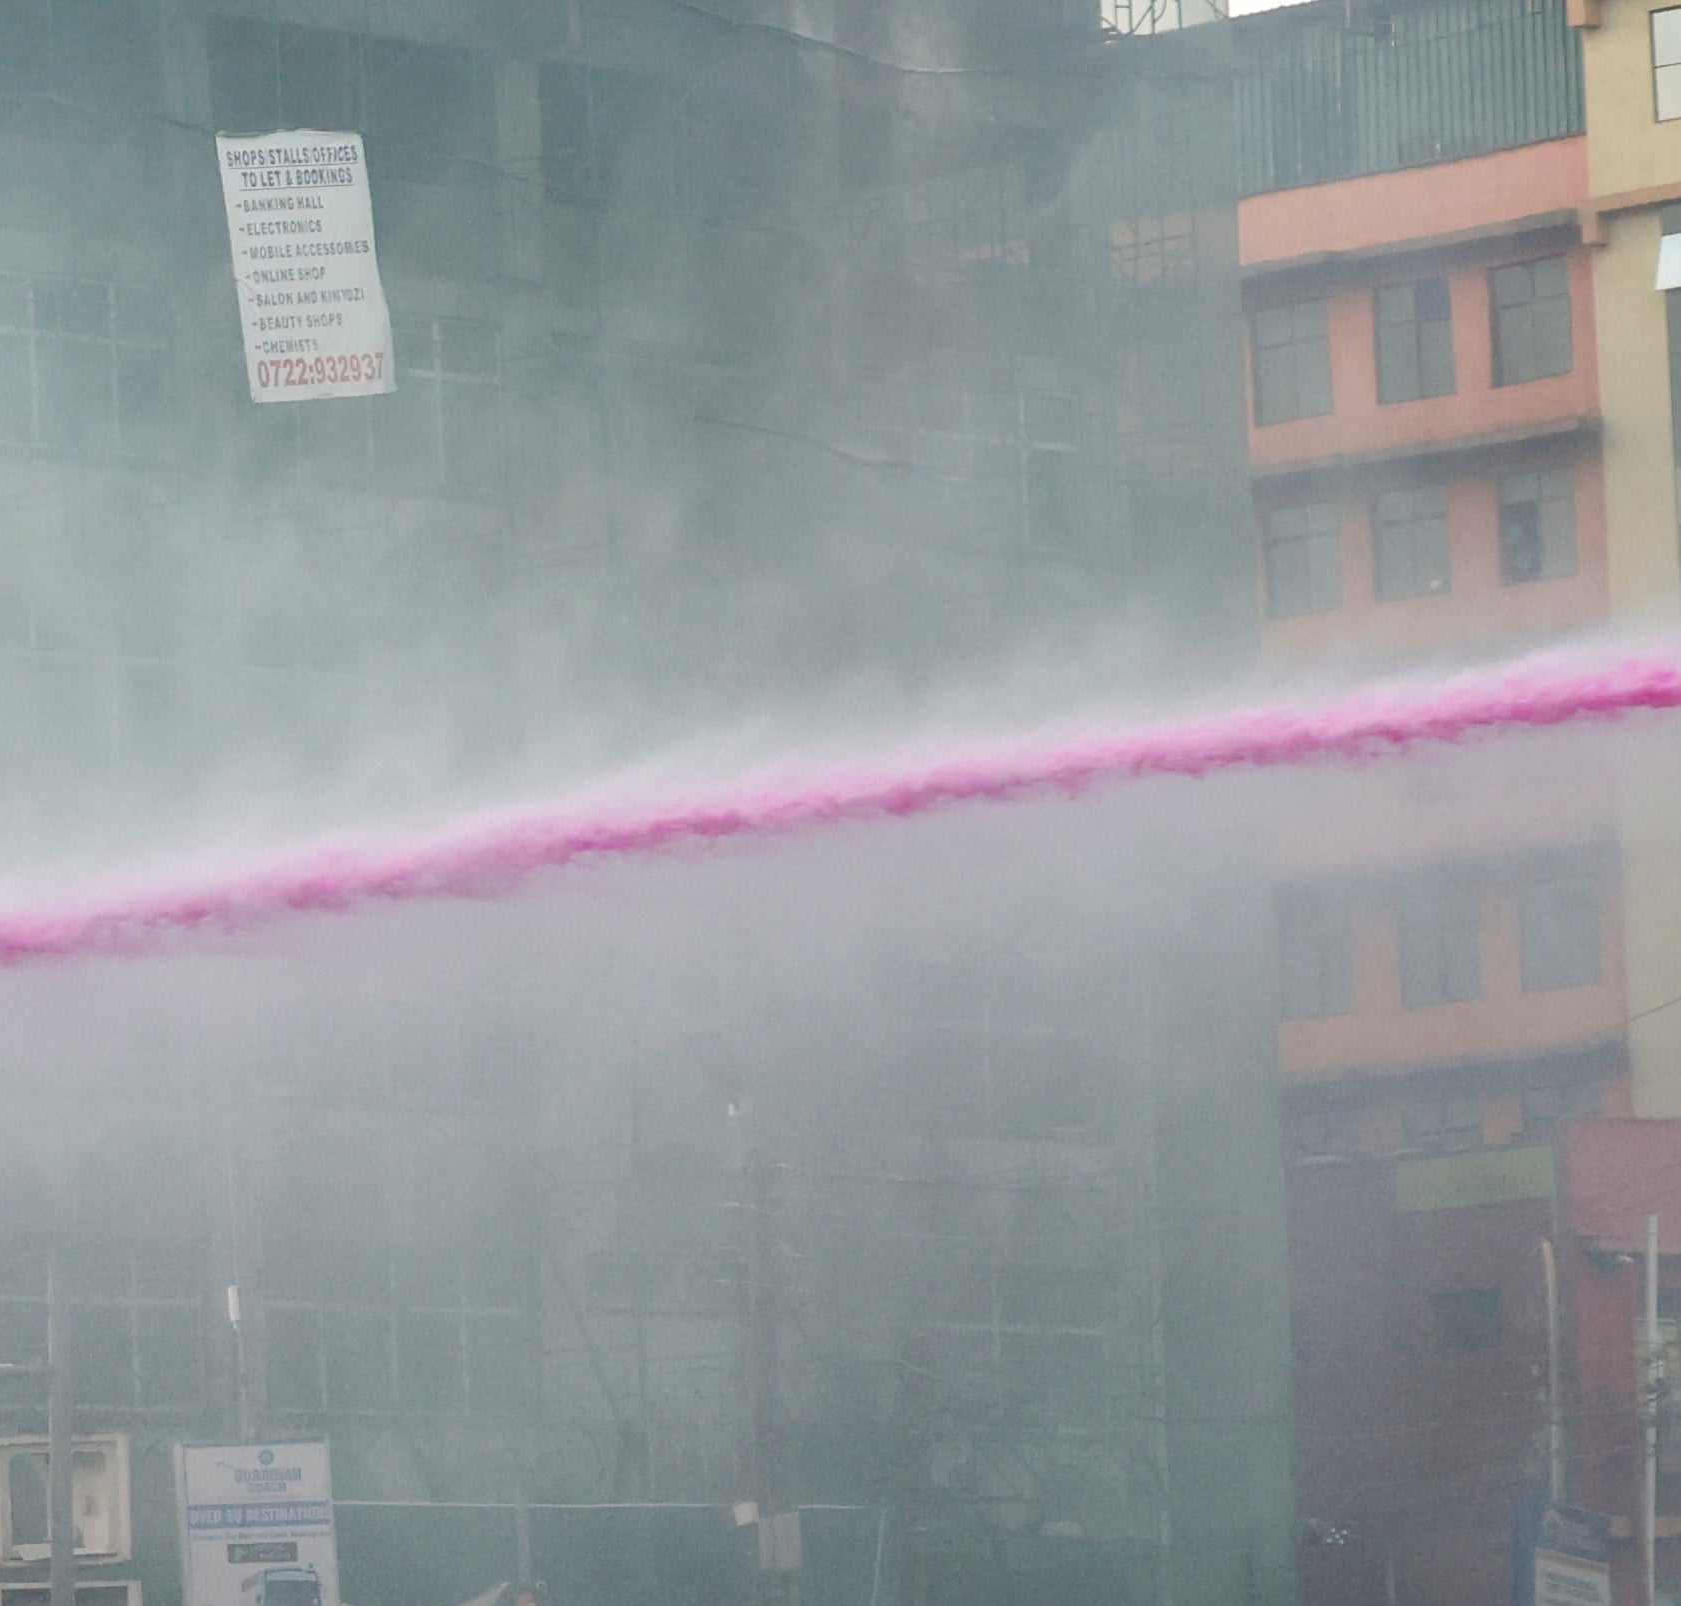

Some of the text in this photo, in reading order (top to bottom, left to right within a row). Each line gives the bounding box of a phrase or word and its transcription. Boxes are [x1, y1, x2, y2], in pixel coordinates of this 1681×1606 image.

[241, 171, 257, 187] TO
[261, 170, 281, 187] LET
[296, 167, 353, 185] BOOKINGS
[297, 196, 324, 210] HALL
[297, 267, 326, 281] SHOP
[297, 290, 318, 305] AND
[306, 313, 343, 328] SHOPS
[257, 352, 385, 388] 0722:932937
